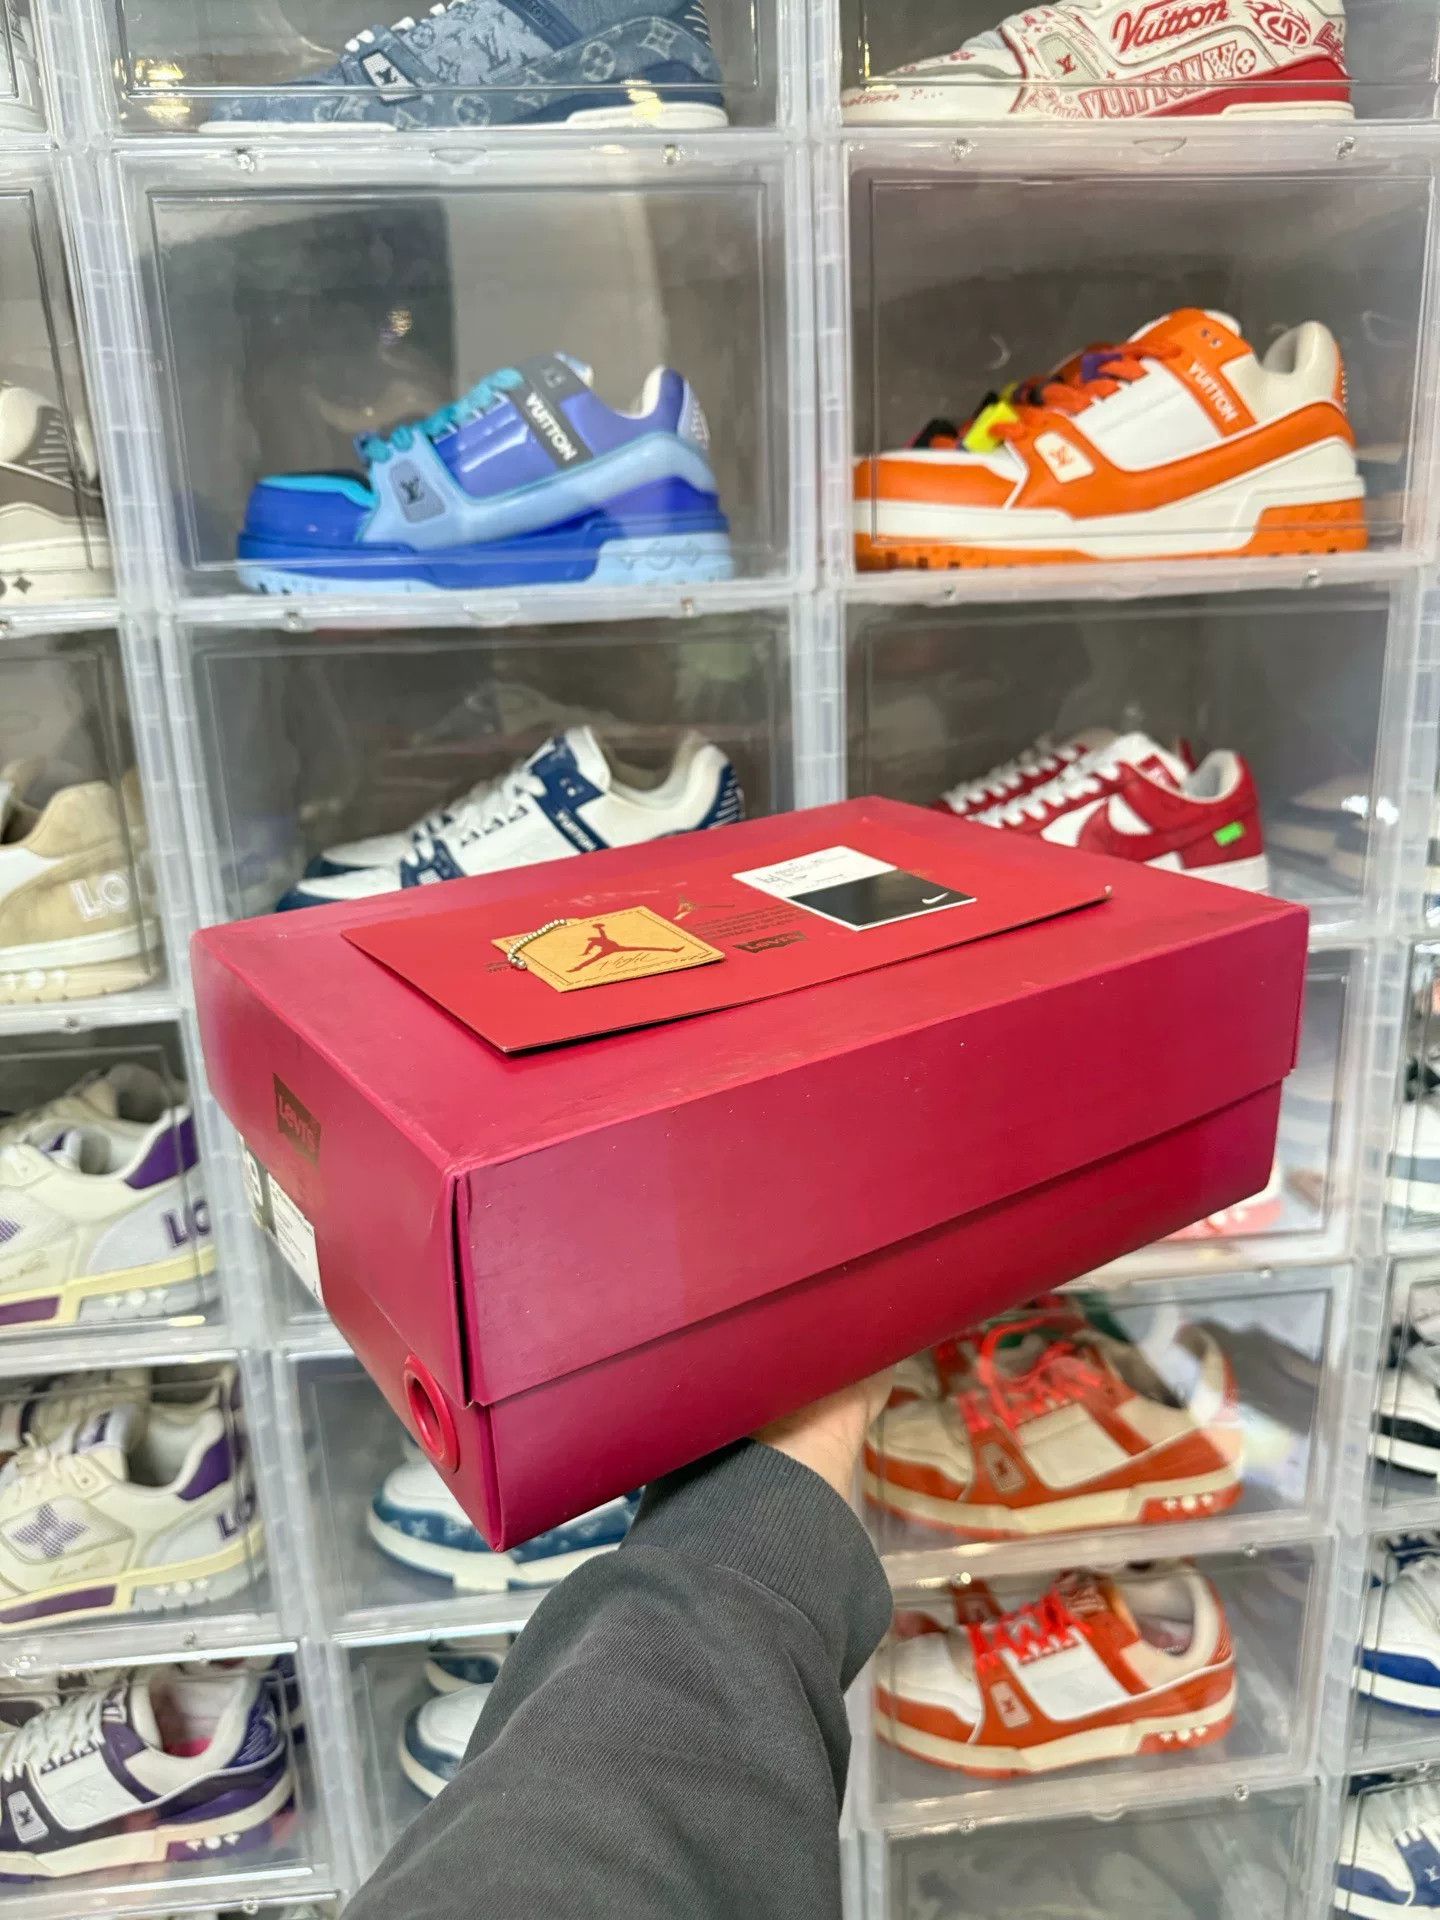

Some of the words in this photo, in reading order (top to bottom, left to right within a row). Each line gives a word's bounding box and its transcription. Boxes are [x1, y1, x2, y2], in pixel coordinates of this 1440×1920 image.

[1111, 0, 1229, 52] Vuitton
[1188, 360, 1239, 423] VUITTON
[526, 392, 578, 462] VUITTON
